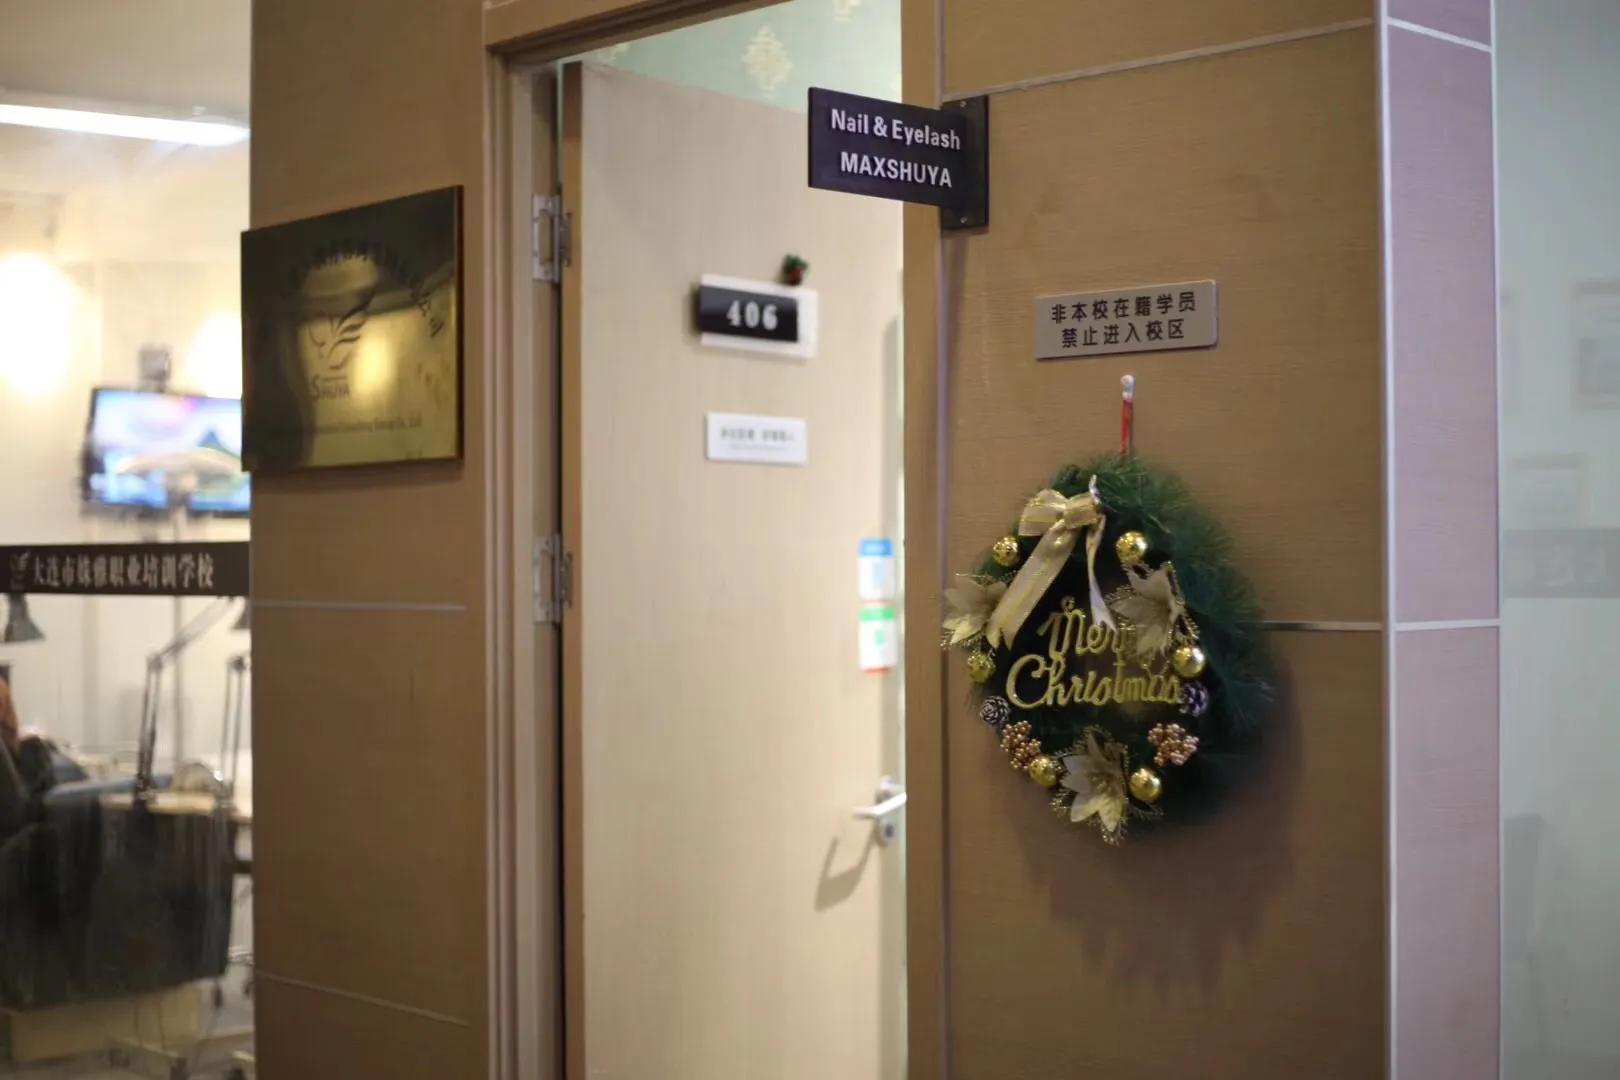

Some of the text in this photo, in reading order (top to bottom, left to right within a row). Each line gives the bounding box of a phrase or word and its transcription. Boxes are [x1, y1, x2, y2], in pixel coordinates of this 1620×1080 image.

[831, 108, 961, 150] Nail & Eyelash
[840, 151, 952, 188] MAXSHUYA
[726, 299, 778, 331] 406
[1051, 291, 1197, 324] 非本校在籍学员
[1061, 318, 1185, 349] 禁止进入校区
[1005, 654, 1181, 709] Christmas
